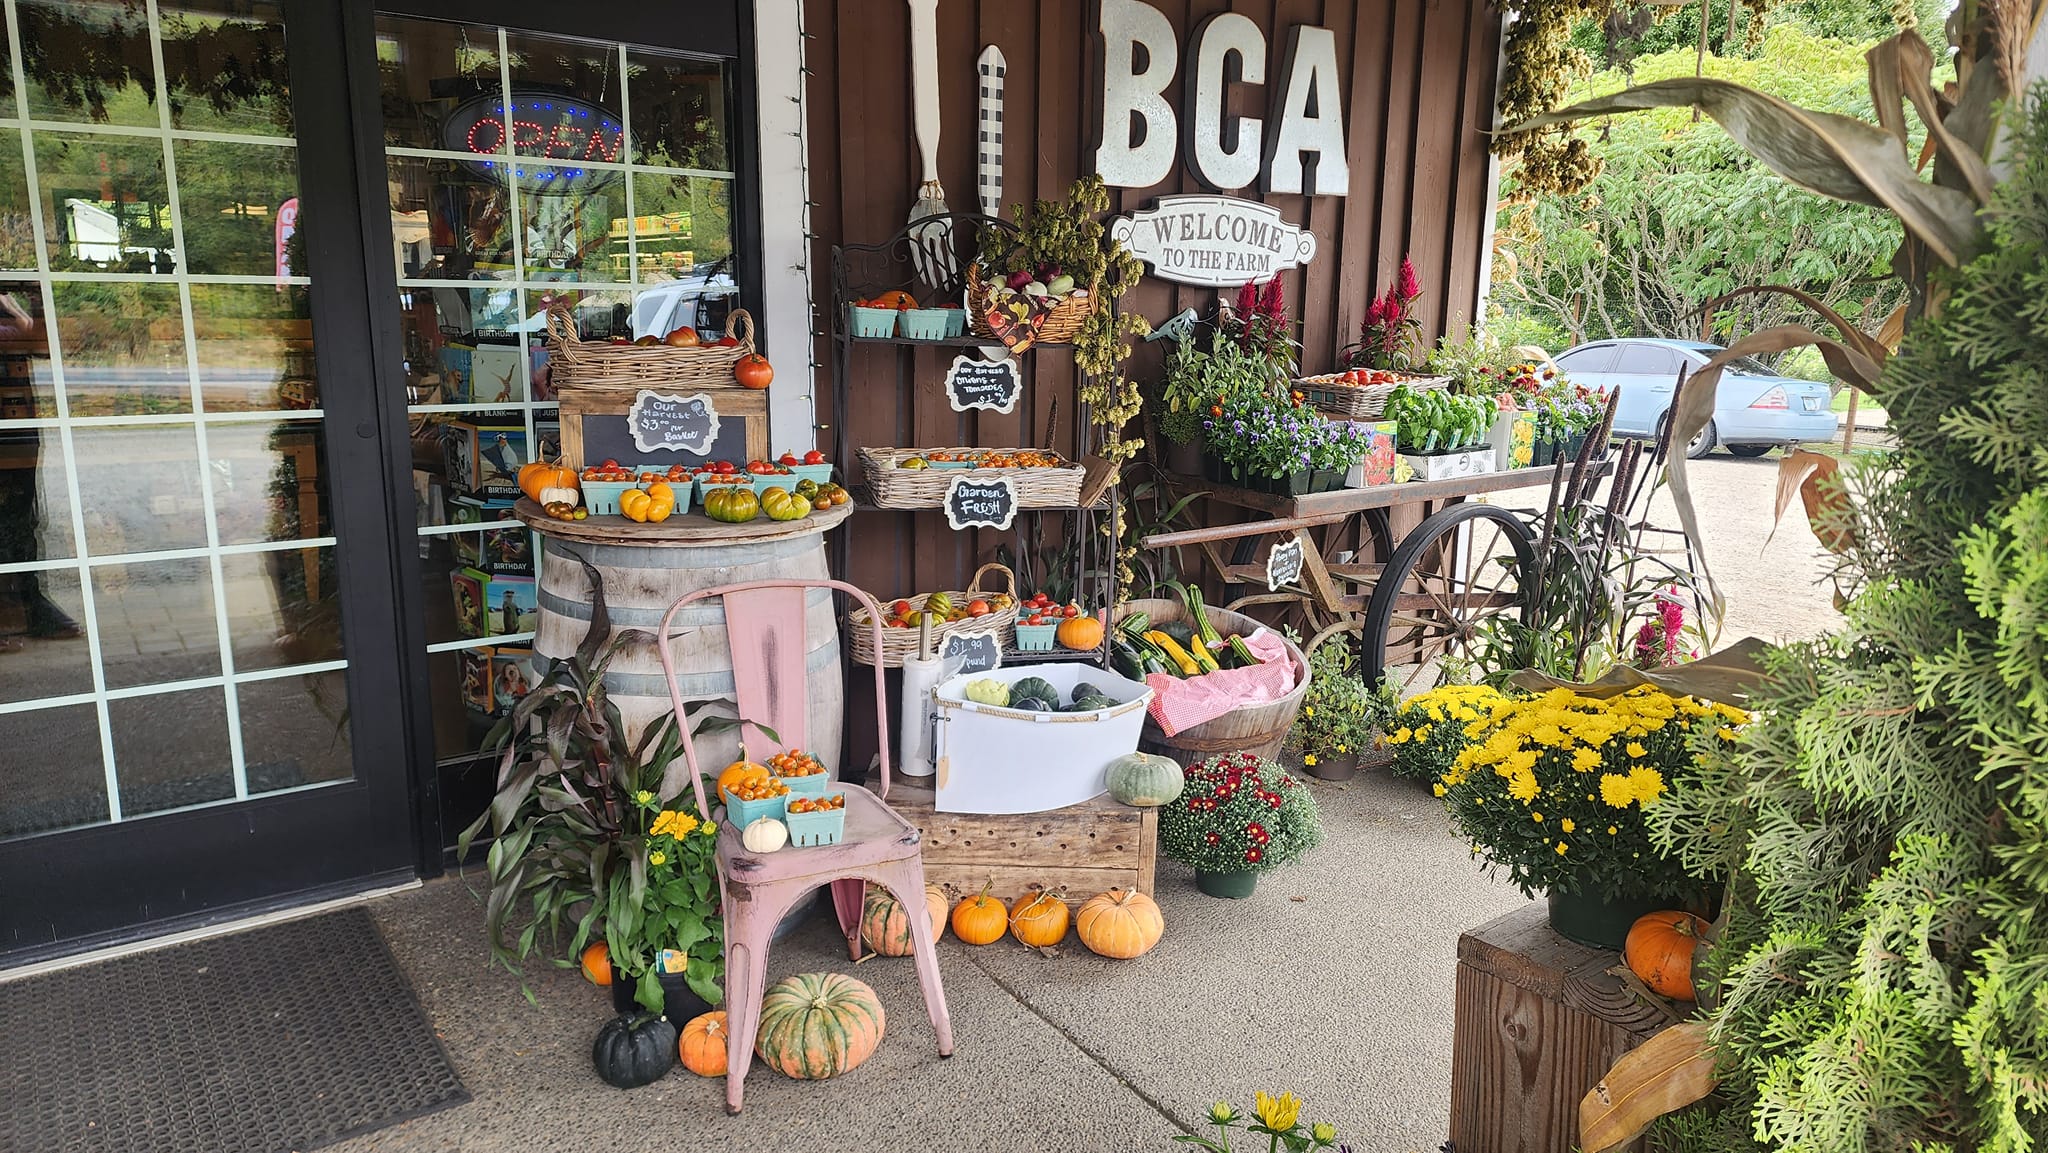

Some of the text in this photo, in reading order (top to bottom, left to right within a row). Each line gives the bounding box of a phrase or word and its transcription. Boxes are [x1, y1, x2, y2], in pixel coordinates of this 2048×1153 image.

[1095, 0, 1350, 196] BCA
[467, 117, 624, 163] OPEN
[1151, 212, 1285, 253] WELCOME
[1162, 247, 1271, 273] TO THE FARM
[478, 329, 515, 338] BIRTHDAY
[484, 409, 507, 417] BLANK
[641, 408, 691, 420] Harvest
[487, 486, 521, 495] BIRTHDAY
[493, 562, 527, 571] BIRTHDAY
